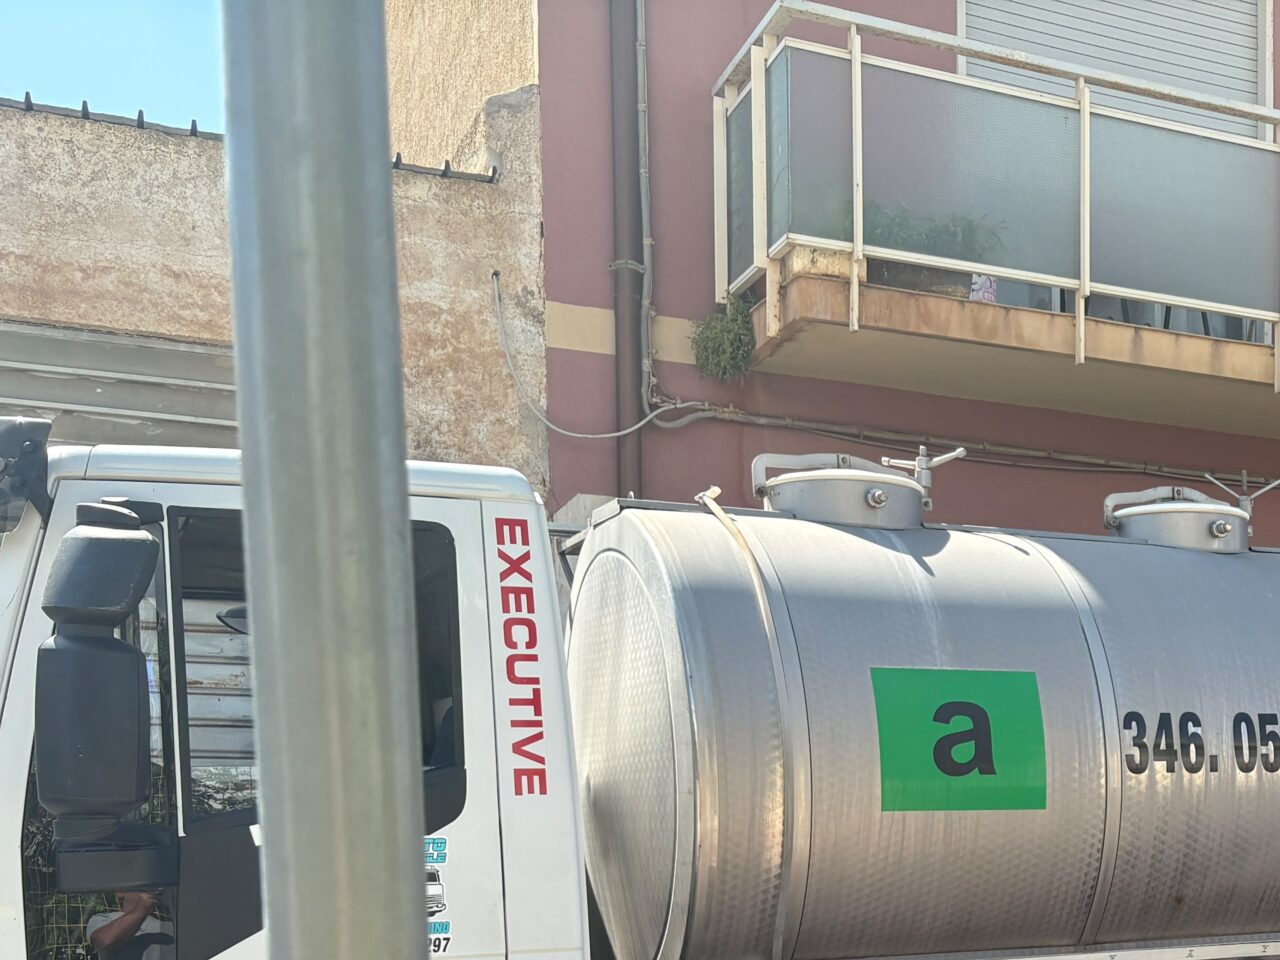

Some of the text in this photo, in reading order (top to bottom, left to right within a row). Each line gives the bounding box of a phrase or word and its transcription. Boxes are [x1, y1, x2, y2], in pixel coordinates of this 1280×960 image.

[494, 517, 548, 797] EXECUTIVE
[932, 700, 998, 777] a
[1122, 710, 1220, 775] 346.
